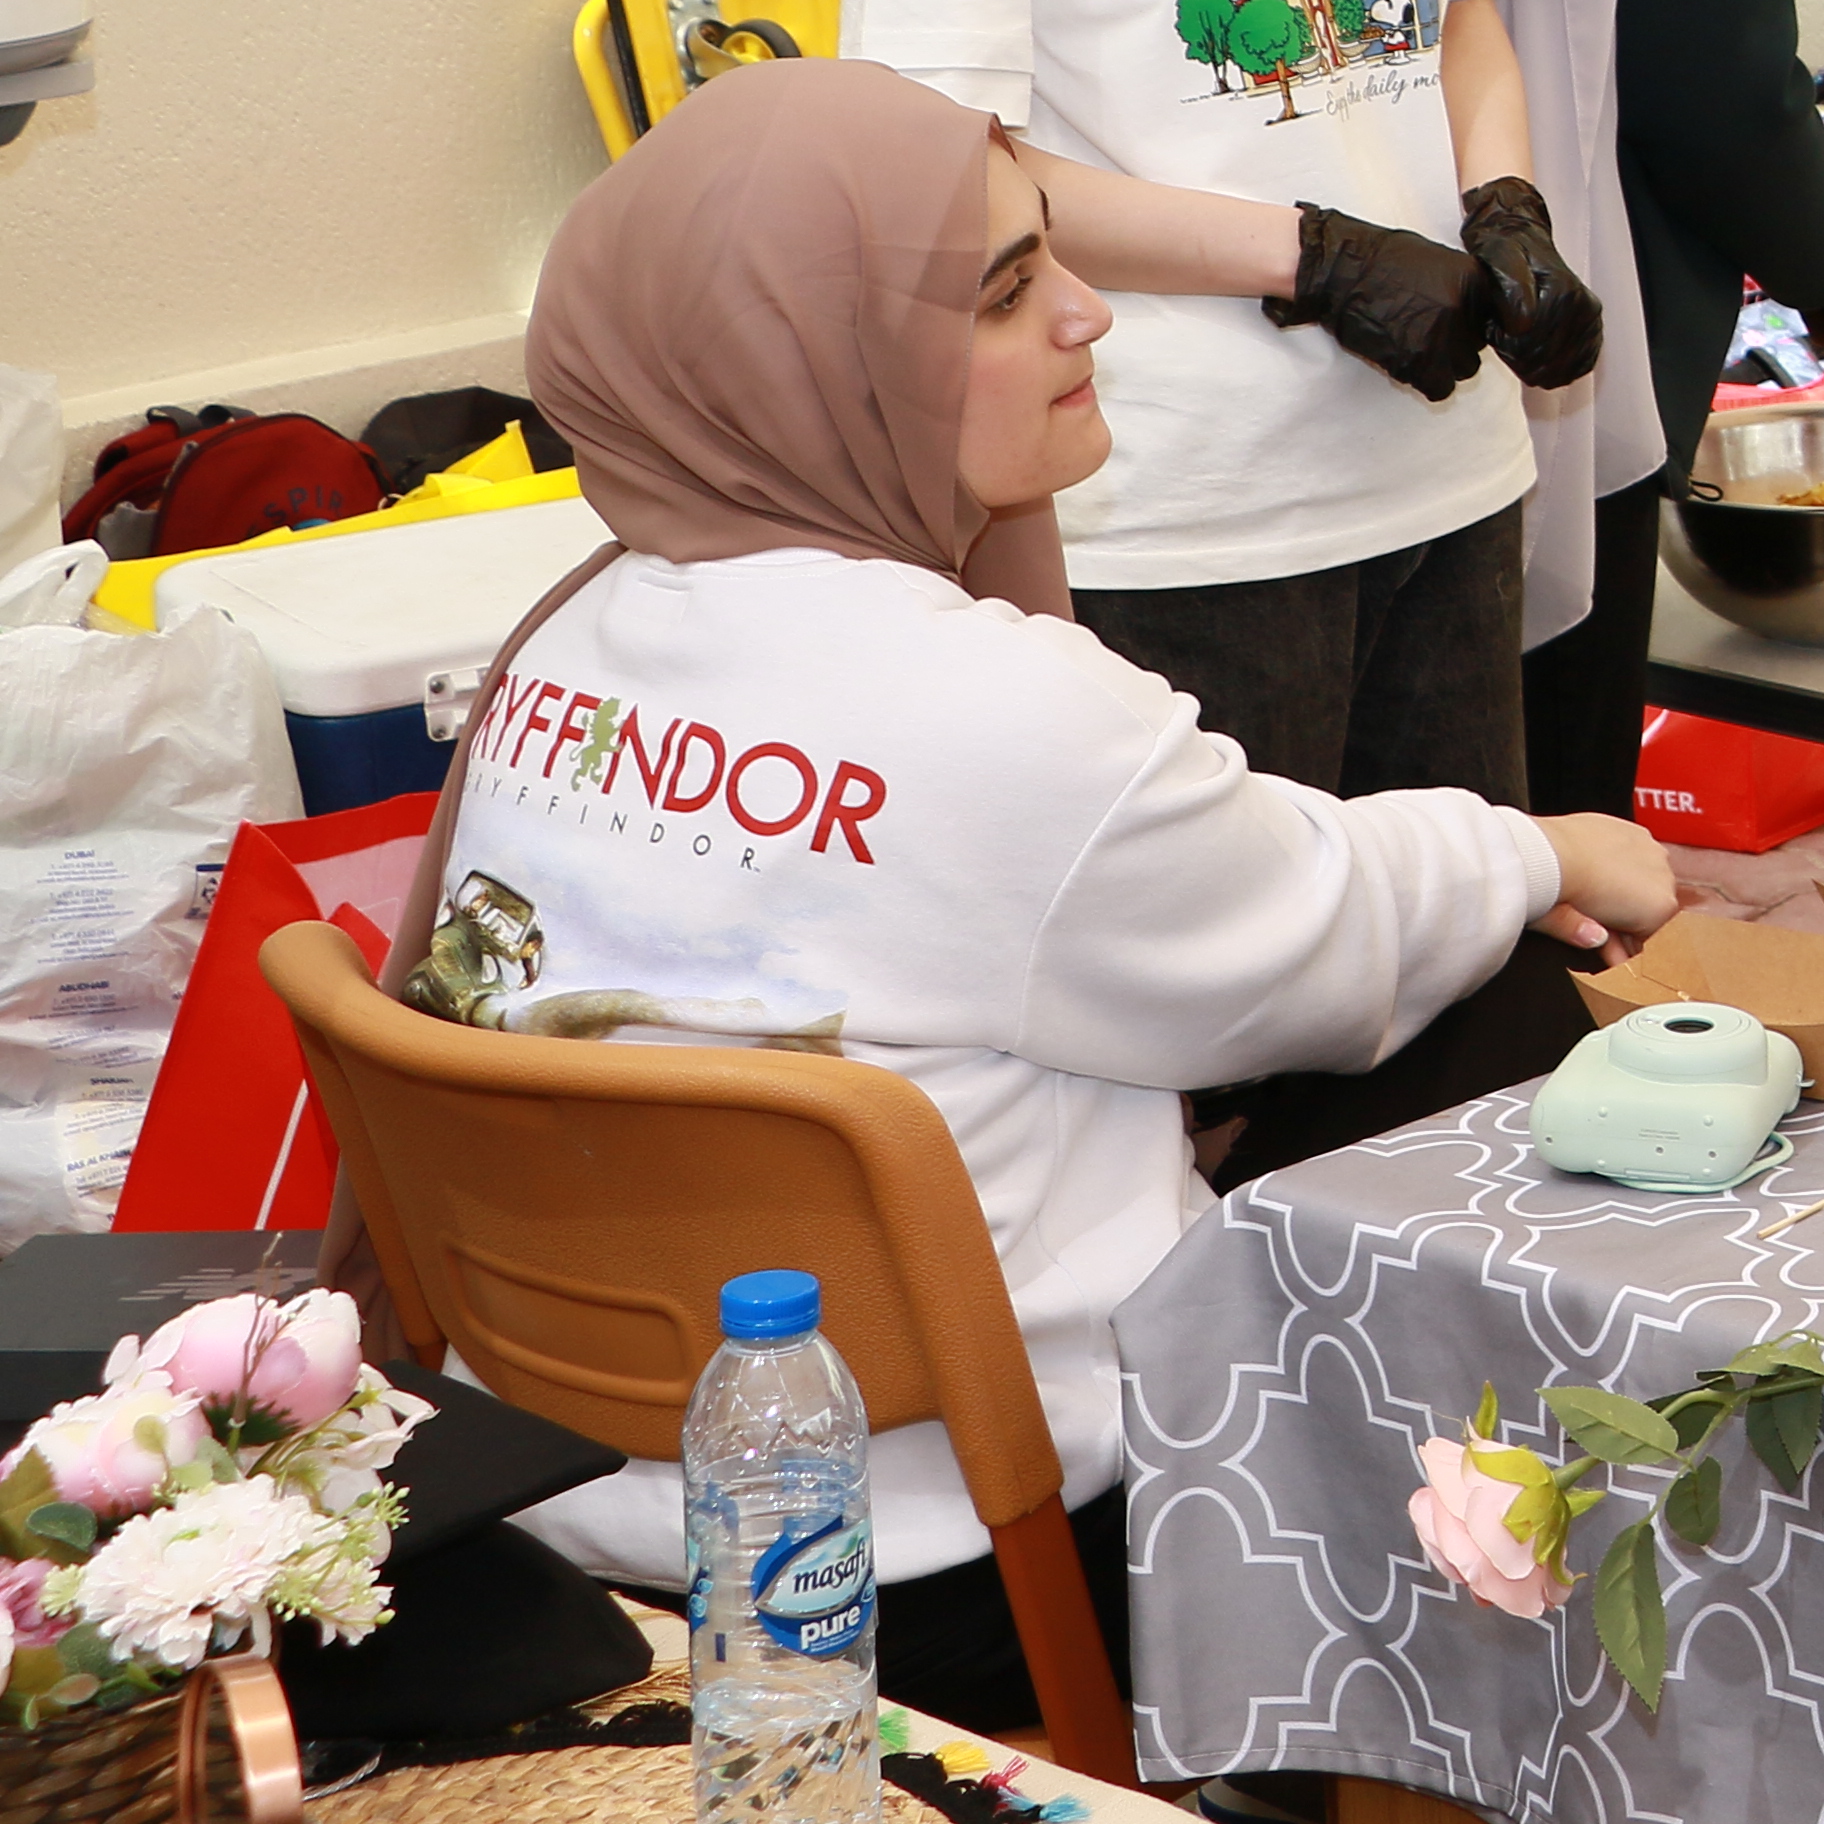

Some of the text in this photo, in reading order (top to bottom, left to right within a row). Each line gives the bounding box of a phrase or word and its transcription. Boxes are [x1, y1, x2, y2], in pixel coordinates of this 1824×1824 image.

[248, 484, 344, 537] SPIR
[470, 672, 888, 866] RYFFINDOR
[1634, 787, 1703, 814] TTER.
[793, 1537, 866, 1594] masafi
[801, 1605, 861, 1651] pure
